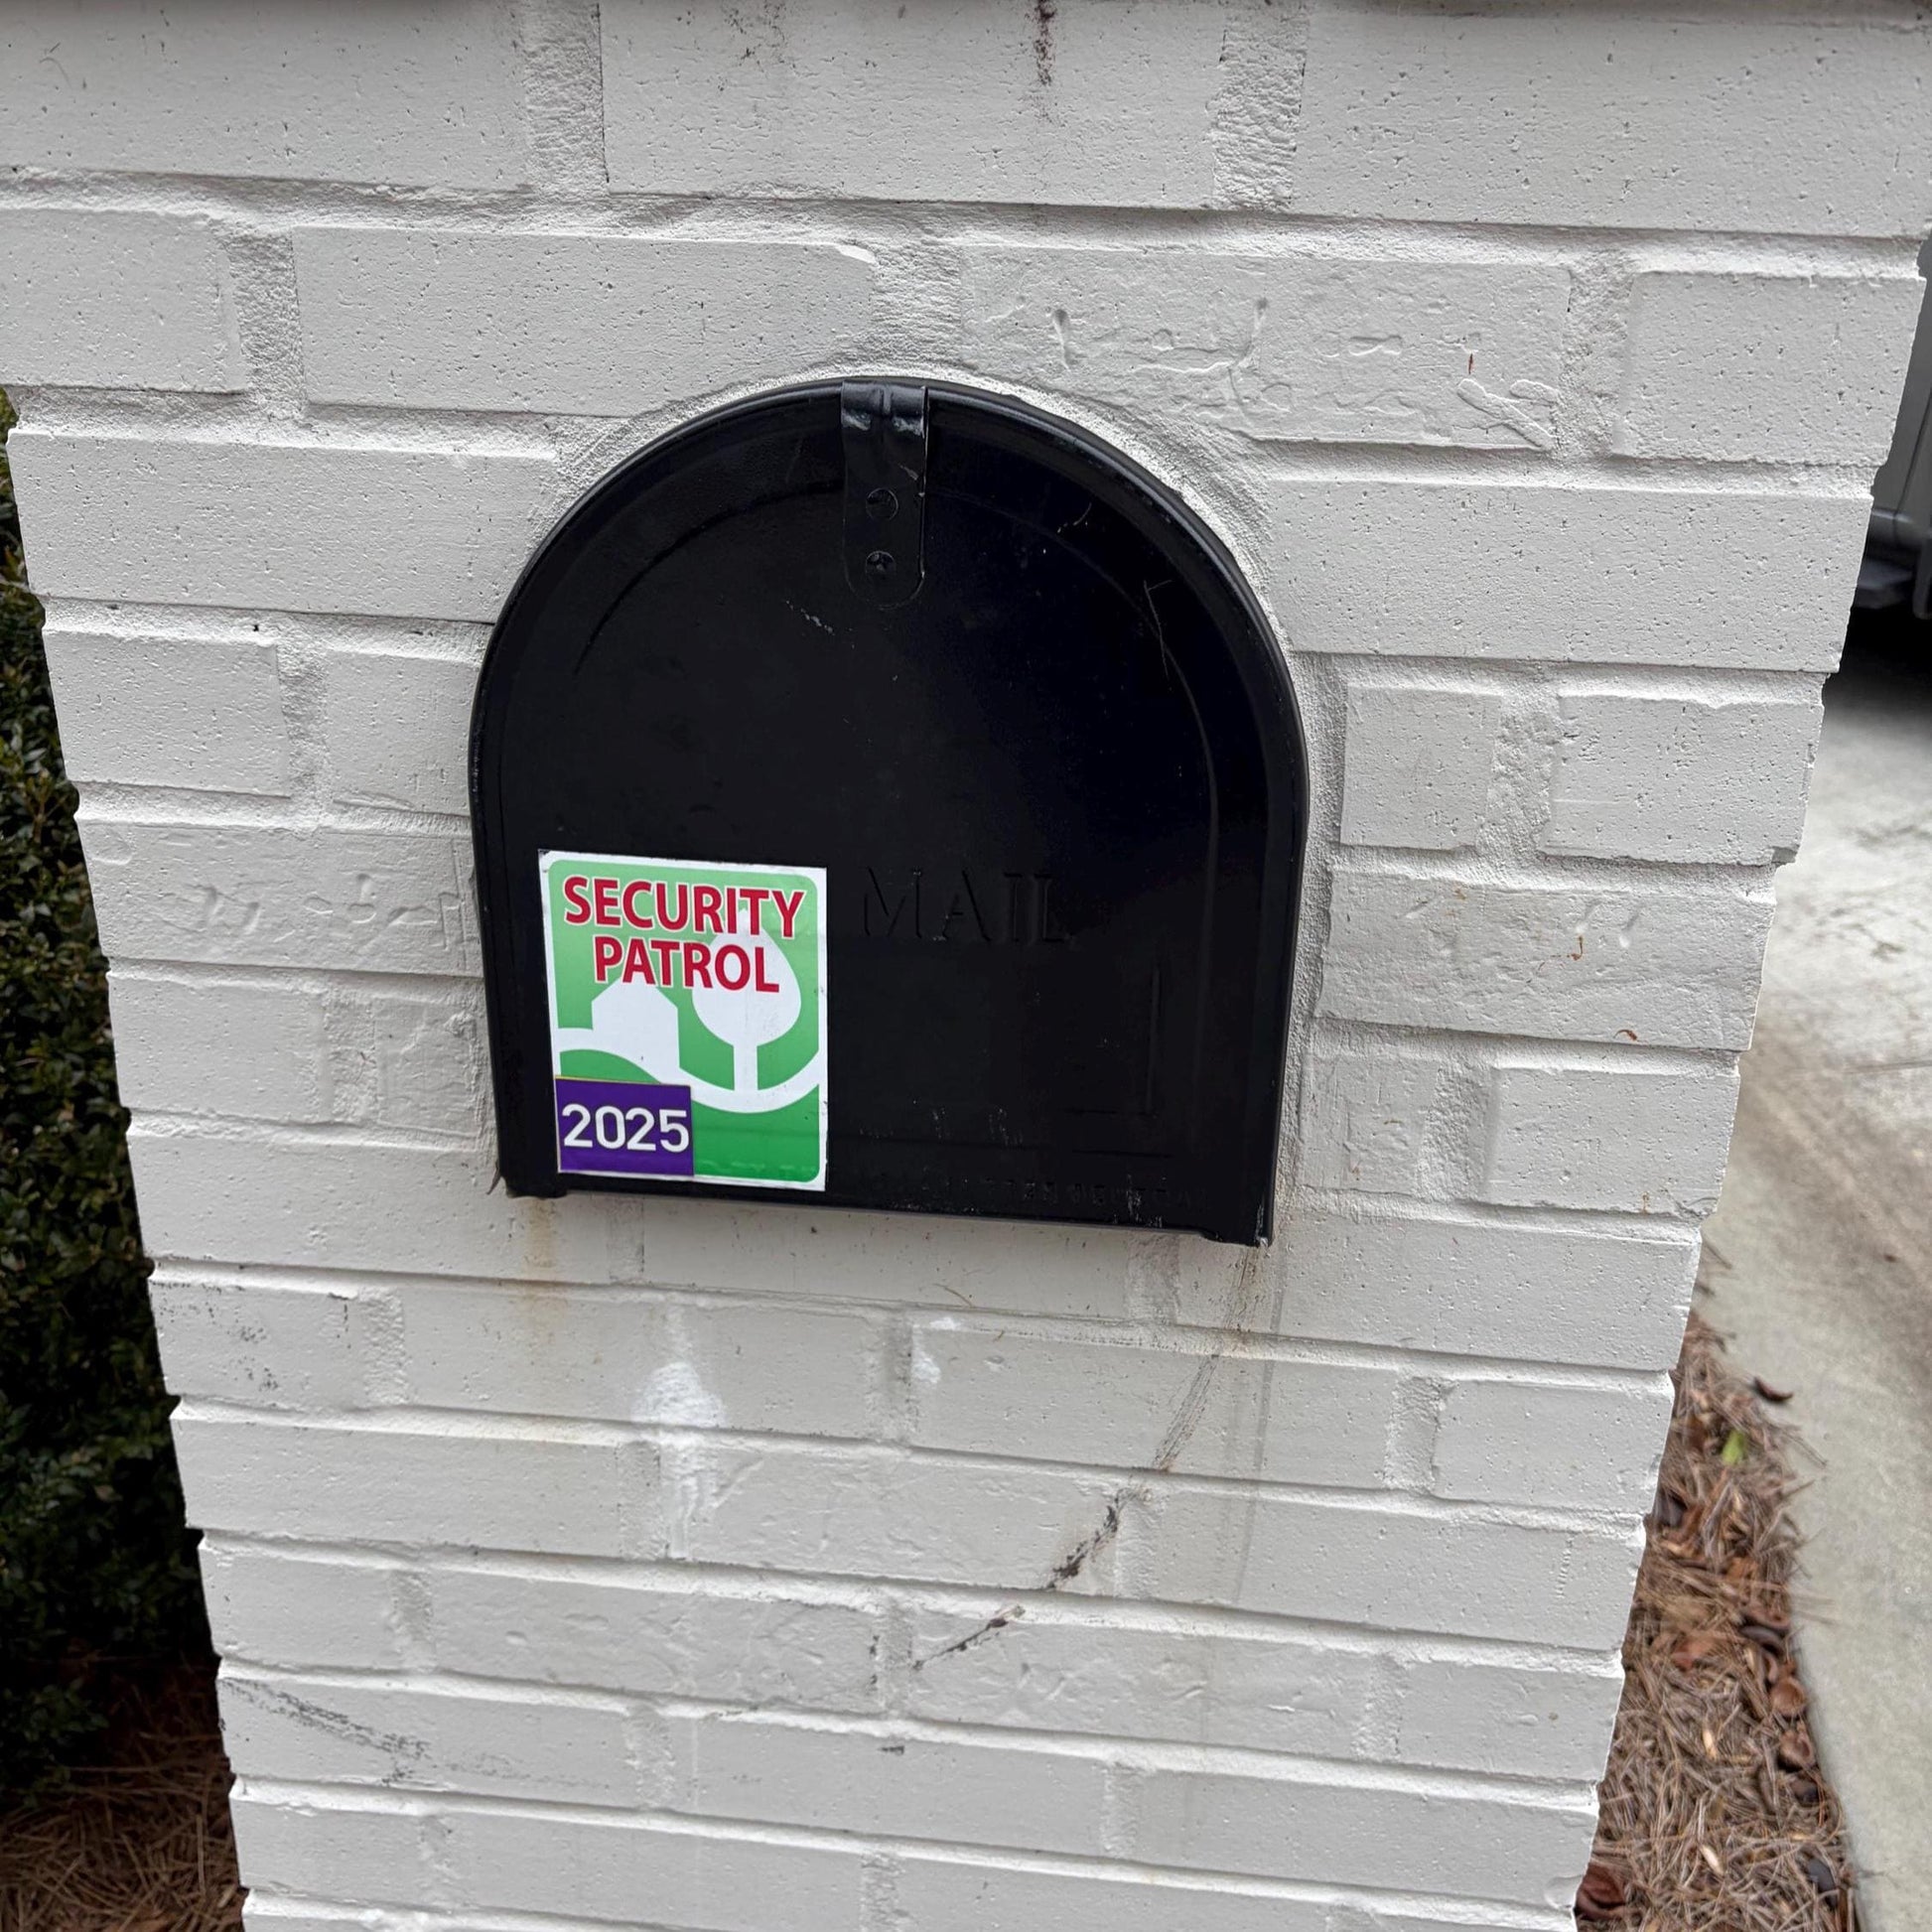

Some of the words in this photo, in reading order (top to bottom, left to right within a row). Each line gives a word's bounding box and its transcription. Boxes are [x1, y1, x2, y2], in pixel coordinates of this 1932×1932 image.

[563, 876, 805, 938] SECURITY
[861, 866, 1066, 942] MAIL
[594, 935, 780, 994] PATROL
[562, 1103, 689, 1153] 2025
